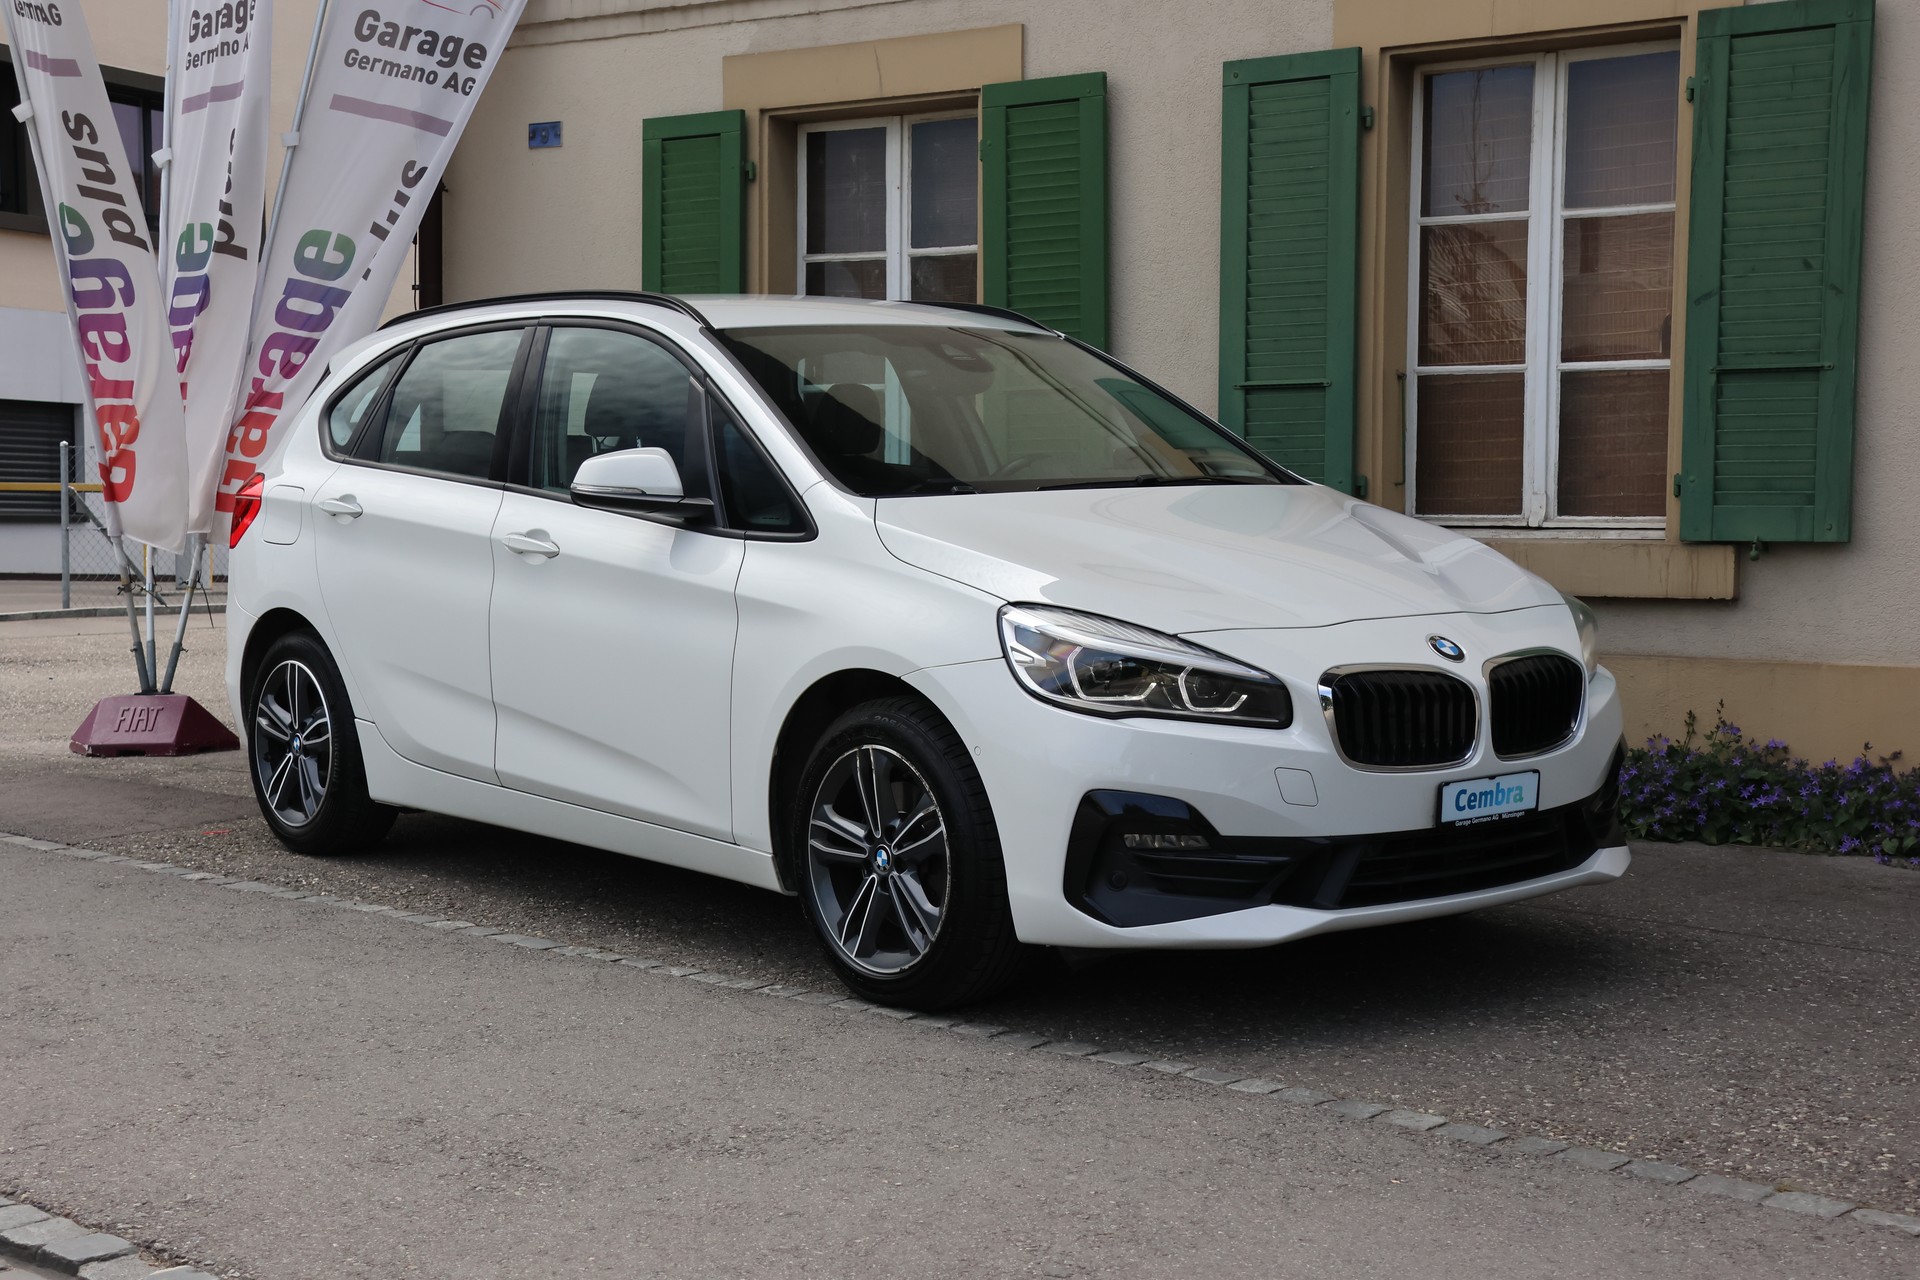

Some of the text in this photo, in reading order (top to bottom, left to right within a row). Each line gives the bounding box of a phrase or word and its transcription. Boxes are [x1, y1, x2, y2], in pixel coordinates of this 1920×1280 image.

[354, 9, 488, 70] Garage
[343, 48, 477, 97] Germano AG
[61, 110, 150, 254] plus
[113, 706, 165, 733] FIAT
[1455, 782, 1524, 812] Cembra
[1472, 816, 1492, 824] Germano
[1501, 811, 1525, 819] Münsingen
